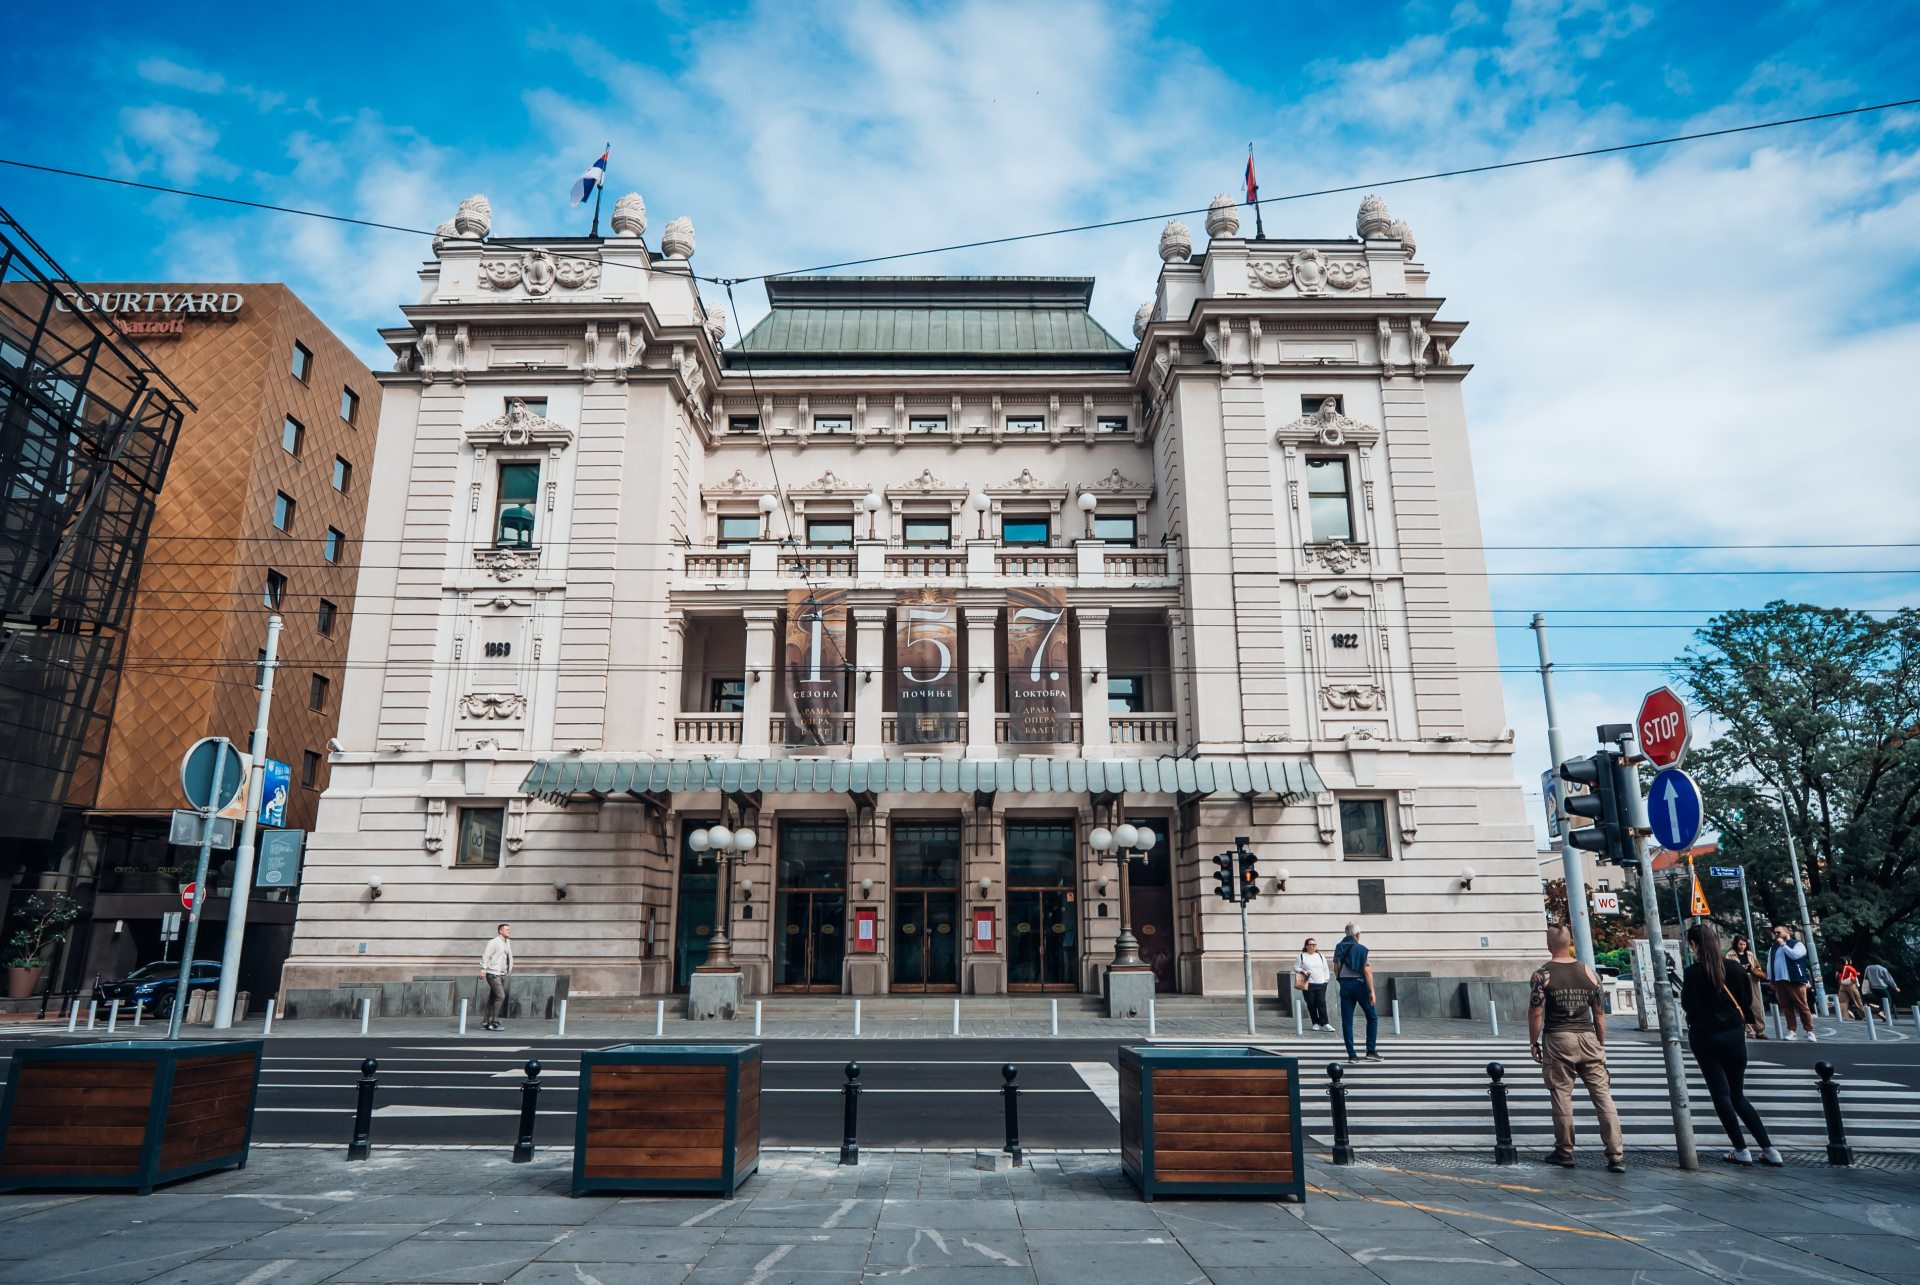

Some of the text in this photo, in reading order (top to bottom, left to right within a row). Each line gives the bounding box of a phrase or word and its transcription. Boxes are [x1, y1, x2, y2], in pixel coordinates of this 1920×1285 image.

[55, 292, 244, 313] COURTYARD
[799, 609, 832, 682] 1
[902, 607, 951, 683] 5
[1331, 633, 1359, 649] 1922
[793, 690, 838, 699] СЕЗОНА
[902, 690, 953, 698] ПОЧИЊЕ
[1022, 689, 1067, 698] ОКТОБРА
[1025, 726, 1057, 734] БАЛЕТ
[1643, 711, 1680, 746] STOP
[1597, 898, 1616, 909] WC
